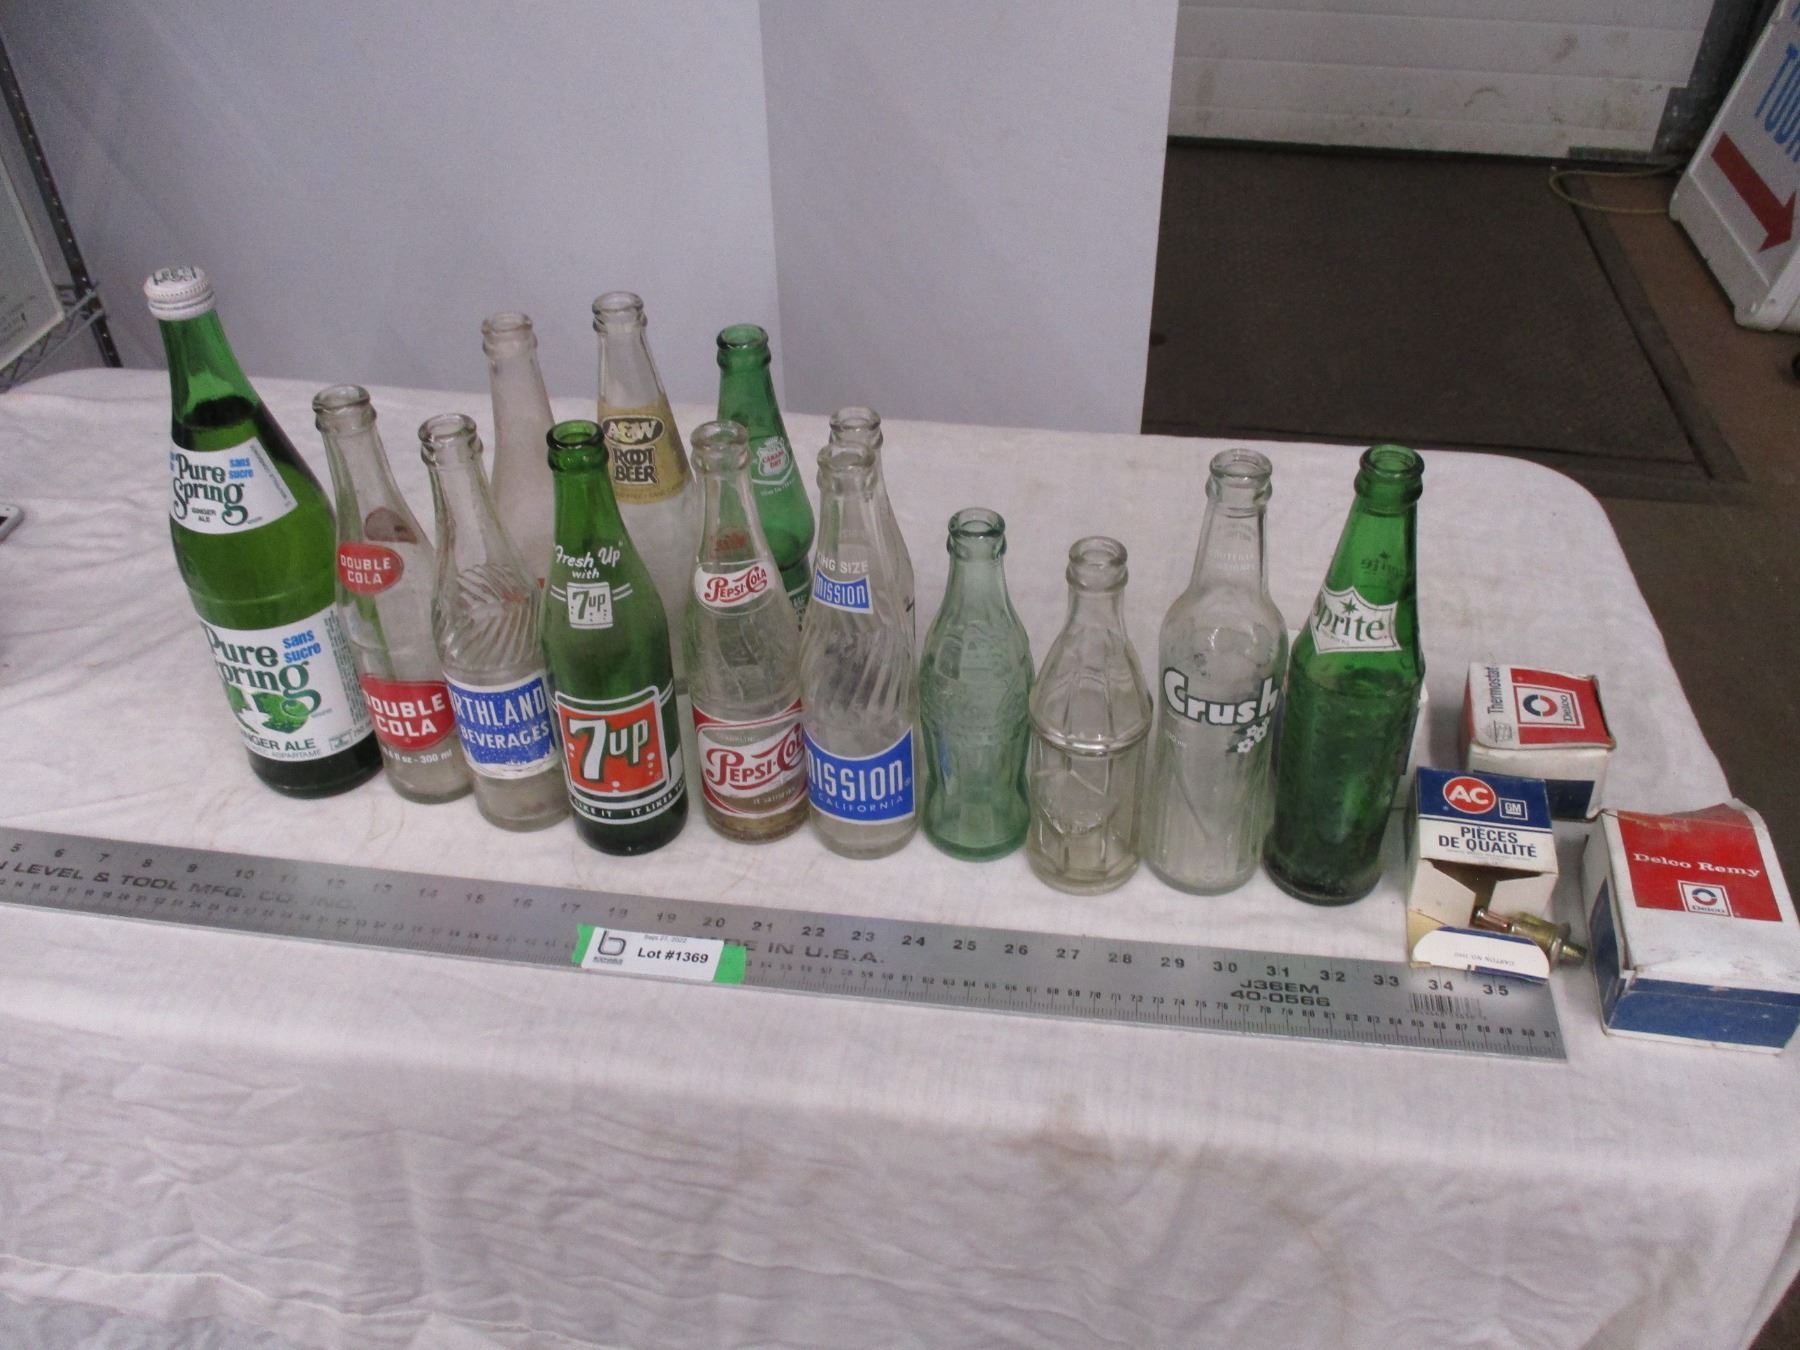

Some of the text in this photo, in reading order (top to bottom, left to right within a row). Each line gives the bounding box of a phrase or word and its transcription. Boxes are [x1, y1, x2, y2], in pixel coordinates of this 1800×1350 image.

[606, 420, 658, 443] A&W
[613, 447, 655, 467] ROOT
[176, 453, 226, 484] Pure
[615, 466, 658, 484] BEER
[173, 477, 249, 526] Spring
[340, 554, 392, 571] DOUBLE
[555, 545, 595, 568] Fresh
[572, 567, 600, 579] with
[840, 560, 869, 574] SIZE
[347, 570, 383, 585] COLA
[282, 630, 315, 649] sans
[215, 642, 322, 717] pring sucre
[1163, 667, 1279, 726] Crush
[1485, 666, 1504, 714] Thermostat
[375, 714, 438, 737] COLA
[461, 722, 550, 748] BEVERAGES
[284, 738, 316, 751] ALE
[419, 753, 439, 765] 300
[818, 795, 904, 813] CALIFORNIA
[1448, 785, 1489, 805] AC
[1504, 802, 1522, 814] GM
[1460, 825, 1518, 844] PIÈCES
[1438, 834, 1460, 849] DE
[1466, 838, 1538, 858] QUALITÉ
[1633, 852, 1760, 878] Delco Remy
[14, 862, 83, 880] LEVEL
[94, 872, 109, 883] &
[121, 874, 179, 890] TOOL
[188, 883, 246, 899] MFG.
[10, 843, 22, 852] 5
[54, 848, 65, 858] 6
[99, 853, 110, 863] 7
[142, 859, 153, 868] 8
[187, 863, 198, 873] 9
[234, 869, 255, 880] 10
[702, 916, 726, 928] 20
[752, 921, 774, 932] 21
[801, 926, 825, 938] 22
[852, 930, 875, 942] 23
[901, 935, 926, 947] 24
[953, 939, 977, 951] 25
[1004, 943, 1029, 956] 26
[1056, 948, 1081, 960] 27
[1108, 952, 1133, 965] 28
[1160, 957, 1185, 969] 29
[1213, 961, 1239, 974] 30
[1266, 966, 1291, 978] 31
[1320, 970, 1346, 983] 32
[1373, 975, 1400, 987] 33
[1429, 979, 1454, 992] 34
[1483, 984, 1509, 997] 35
[637, 947, 661, 959] Lot
[665, 951, 709, 964] #1369
[768, 942, 794, 954] IN
[805, 946, 885, 964] U.S.A.
[1240, 979, 1320, 995] J36EM
